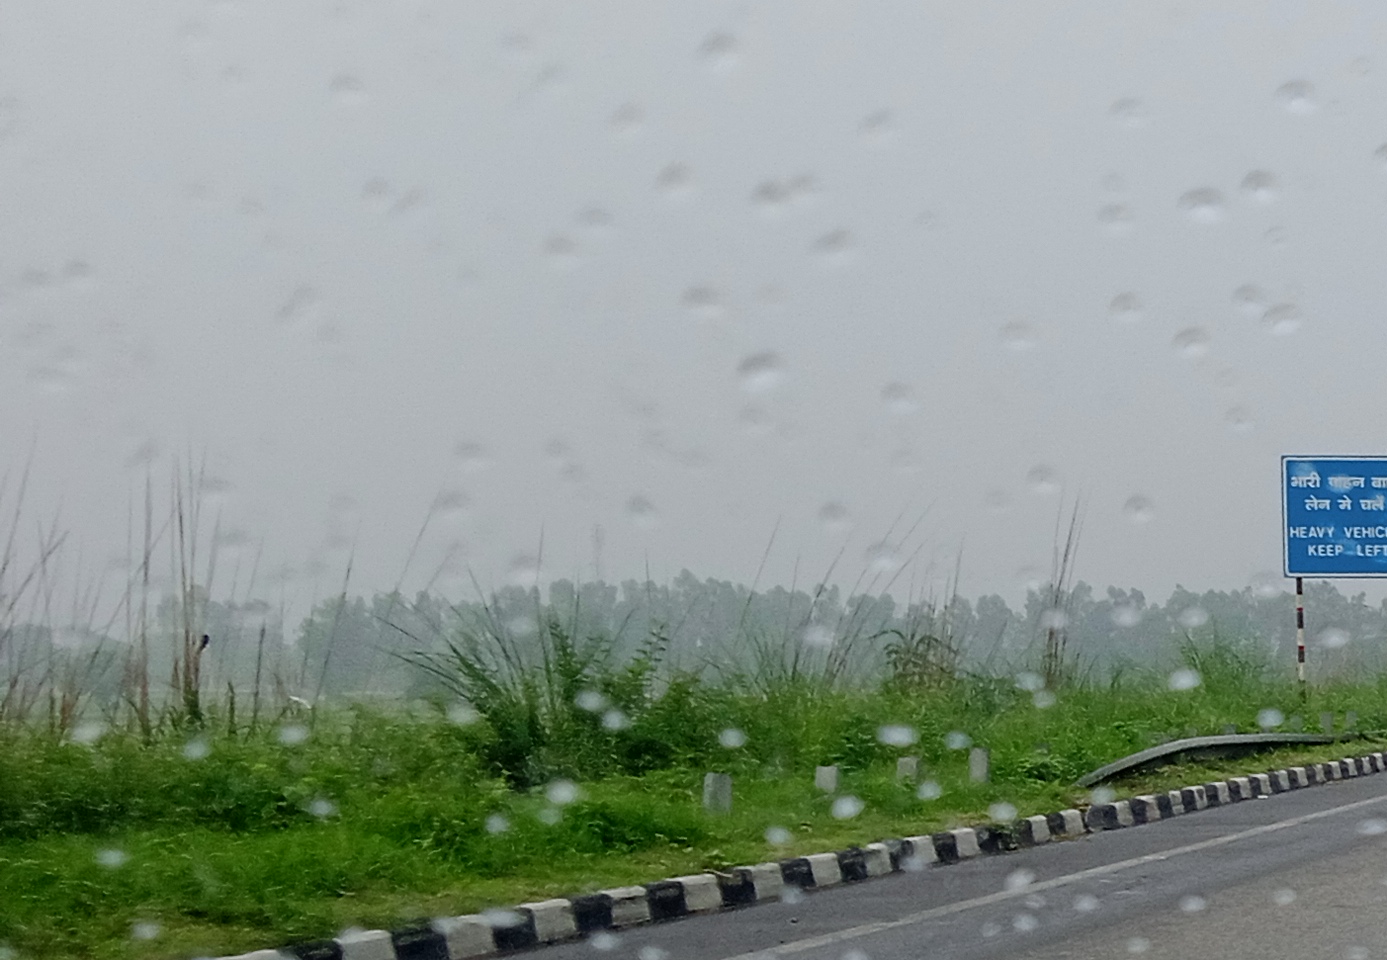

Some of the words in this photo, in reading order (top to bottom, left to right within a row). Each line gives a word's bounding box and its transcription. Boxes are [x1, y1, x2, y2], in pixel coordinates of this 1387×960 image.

[1290, 472, 1321, 488] भारी
[1304, 495, 1331, 511] लेन
[1290, 526, 1335, 539] HEAVY
[1308, 544, 1344, 557] KEEP
